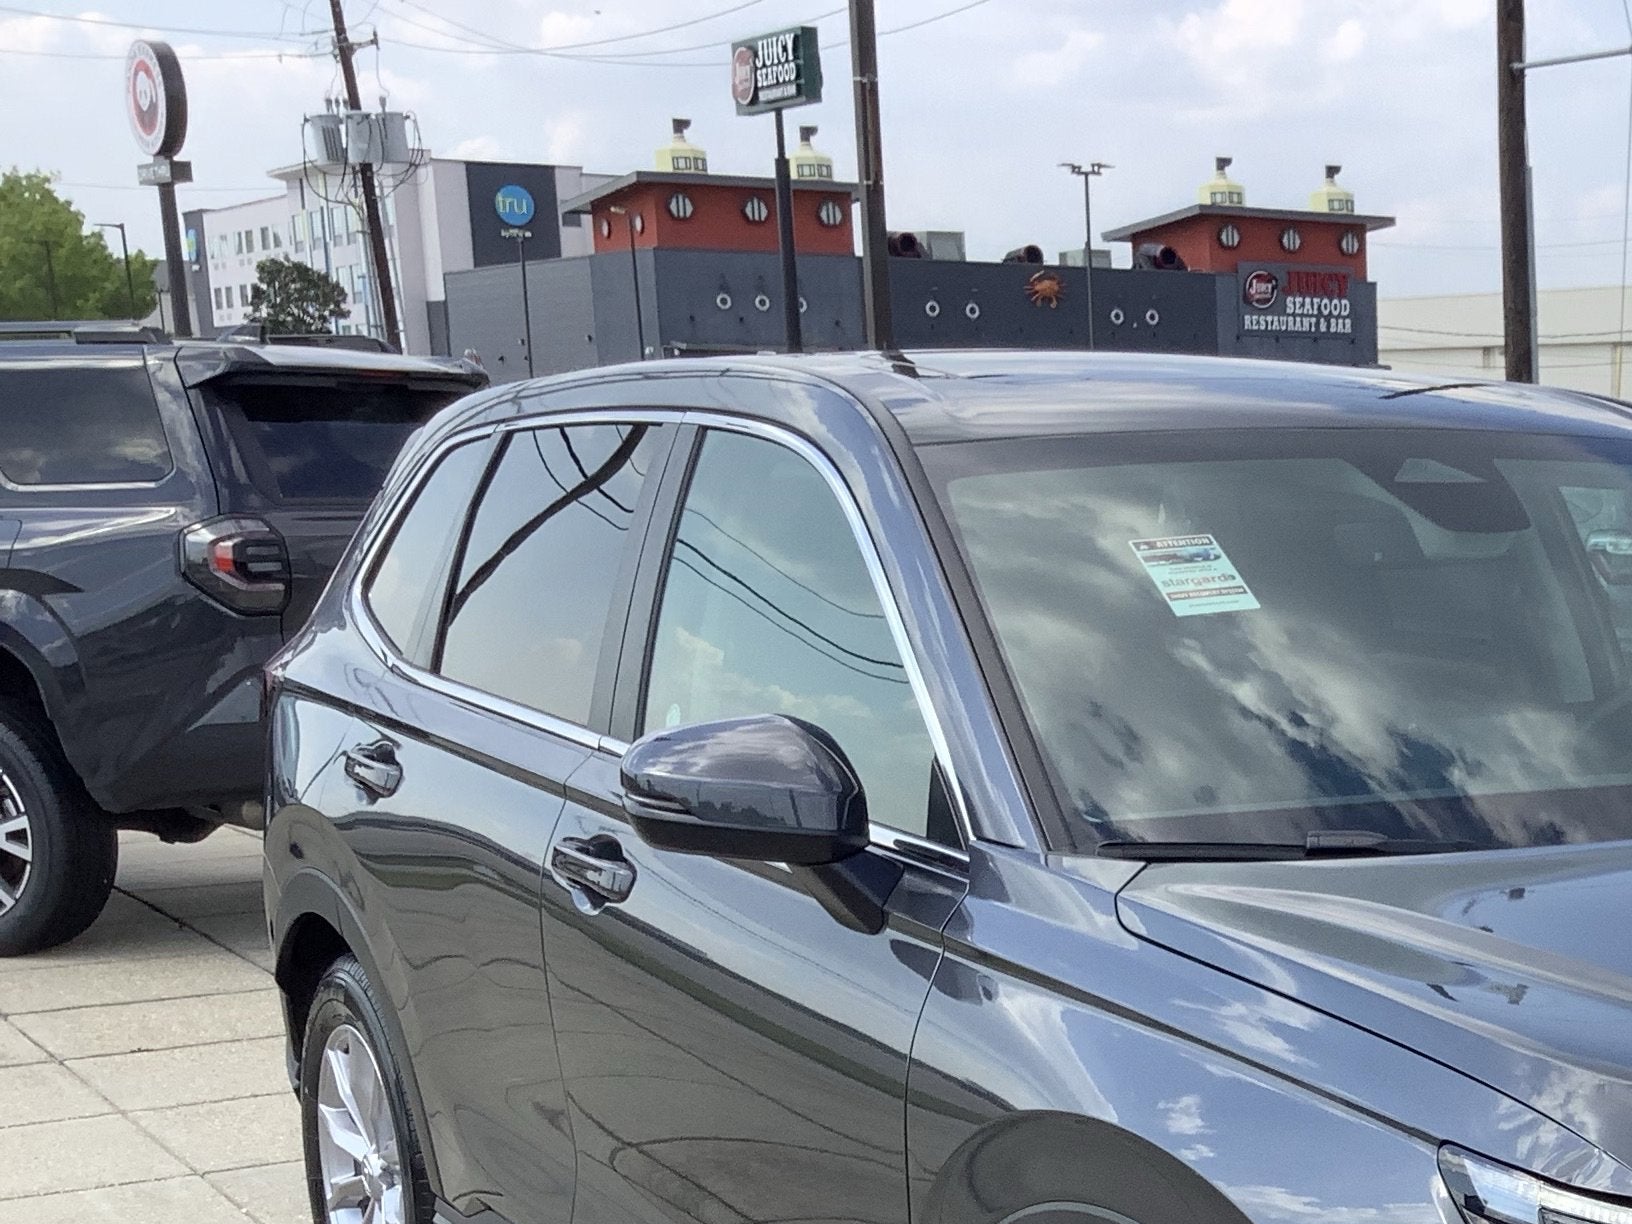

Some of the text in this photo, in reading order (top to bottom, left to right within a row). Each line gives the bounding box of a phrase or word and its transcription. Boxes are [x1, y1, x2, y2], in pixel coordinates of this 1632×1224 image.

[755, 33, 795, 68] JUICY
[757, 61, 796, 87] SEAFOOD
[497, 192, 528, 214] tru
[1285, 296, 1350, 316] SEAFOOD
[1244, 315, 1352, 333] RESTAURANT & BAR
[1156, 537, 1210, 548] ATTENTION
